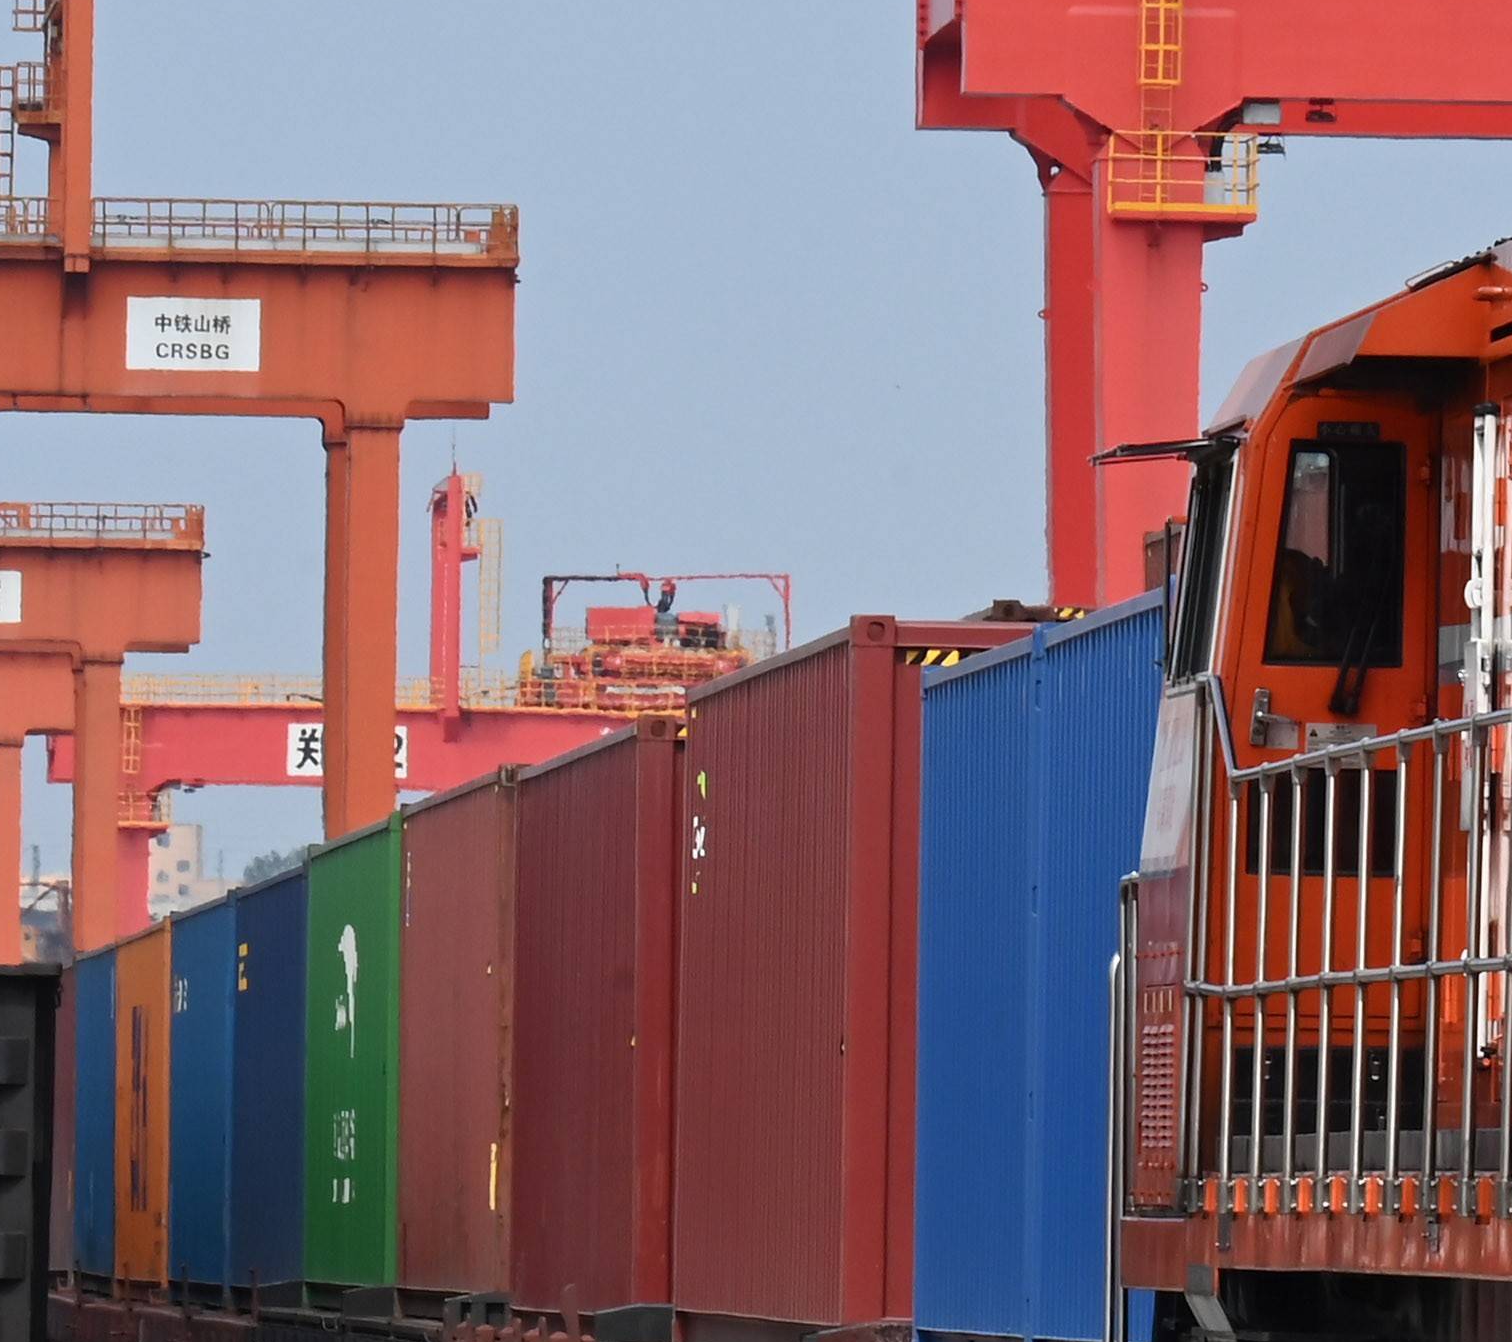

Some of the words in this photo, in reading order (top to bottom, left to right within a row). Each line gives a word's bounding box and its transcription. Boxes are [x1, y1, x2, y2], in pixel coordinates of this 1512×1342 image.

[155, 314, 232, 336] 中铁山桥
[155, 340, 231, 361] CRSBG
